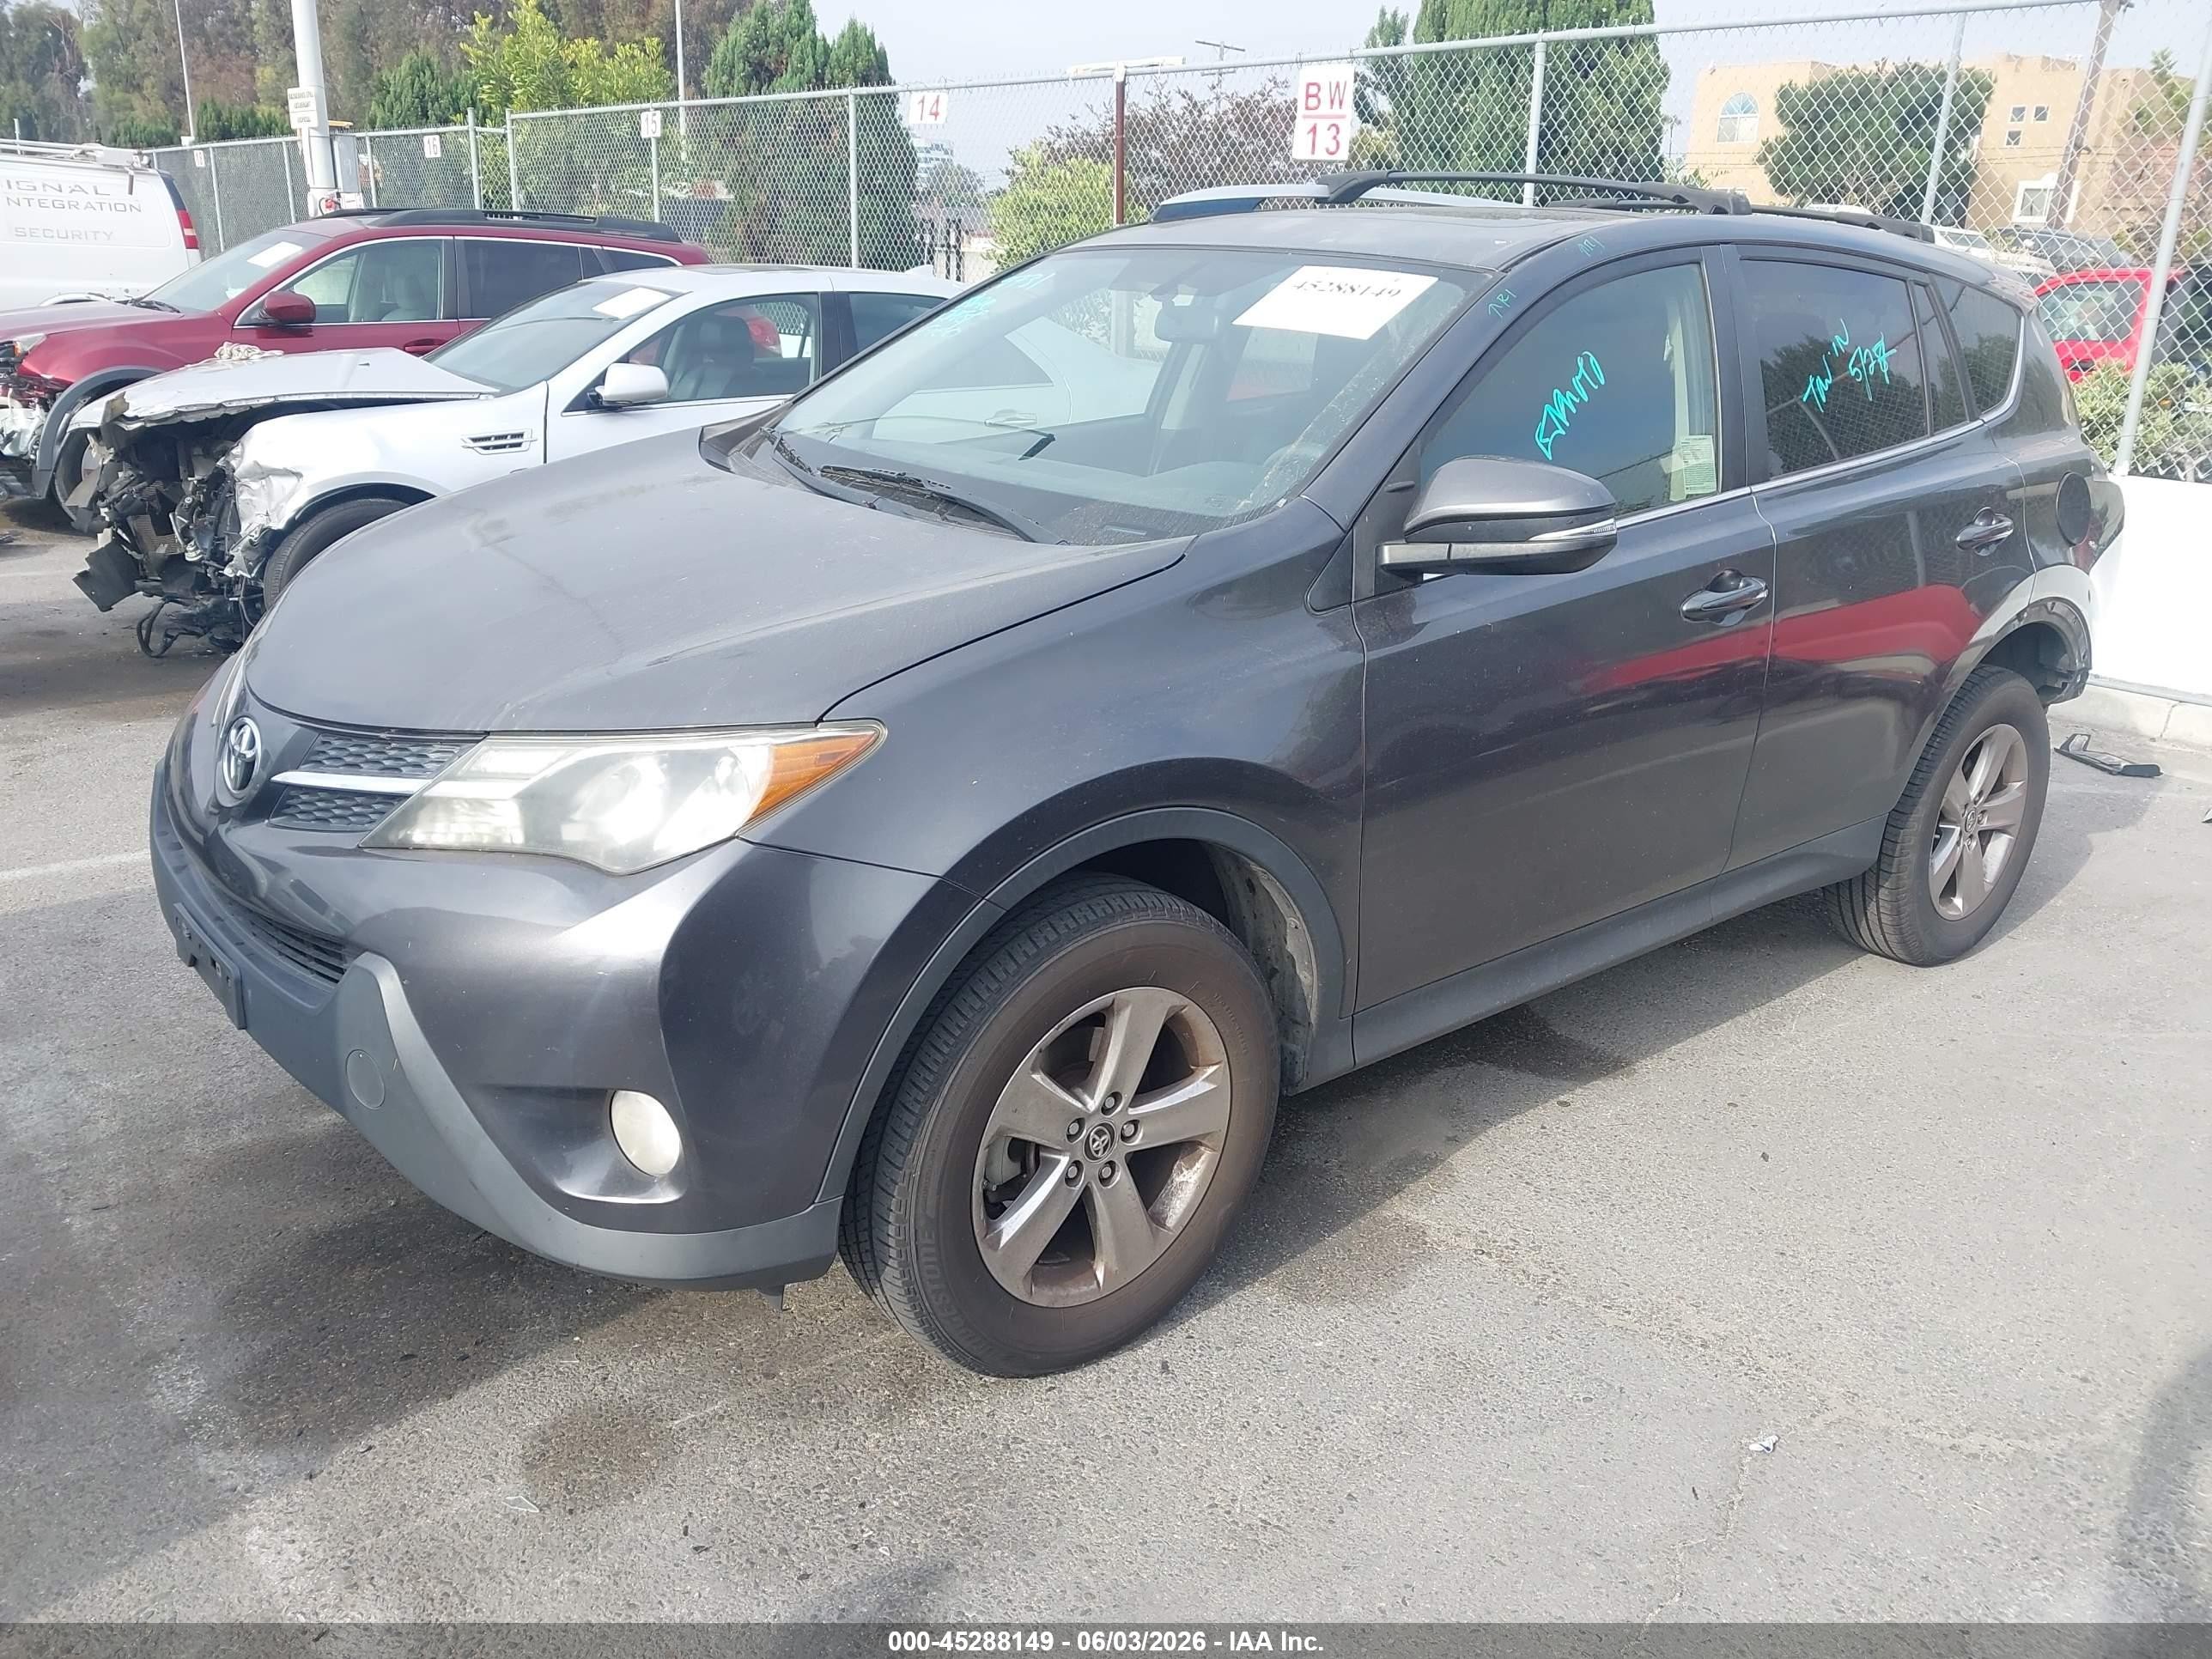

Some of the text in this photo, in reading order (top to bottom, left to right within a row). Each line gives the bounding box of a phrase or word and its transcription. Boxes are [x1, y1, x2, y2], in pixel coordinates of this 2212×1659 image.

[918, 94, 940, 122] 14
[1304, 81, 1347, 111] BW
[644, 112, 657, 136] 15
[427, 137, 439, 156] 16
[1306, 123, 1340, 156] 13
[14, 226, 114, 241] SECURITY
